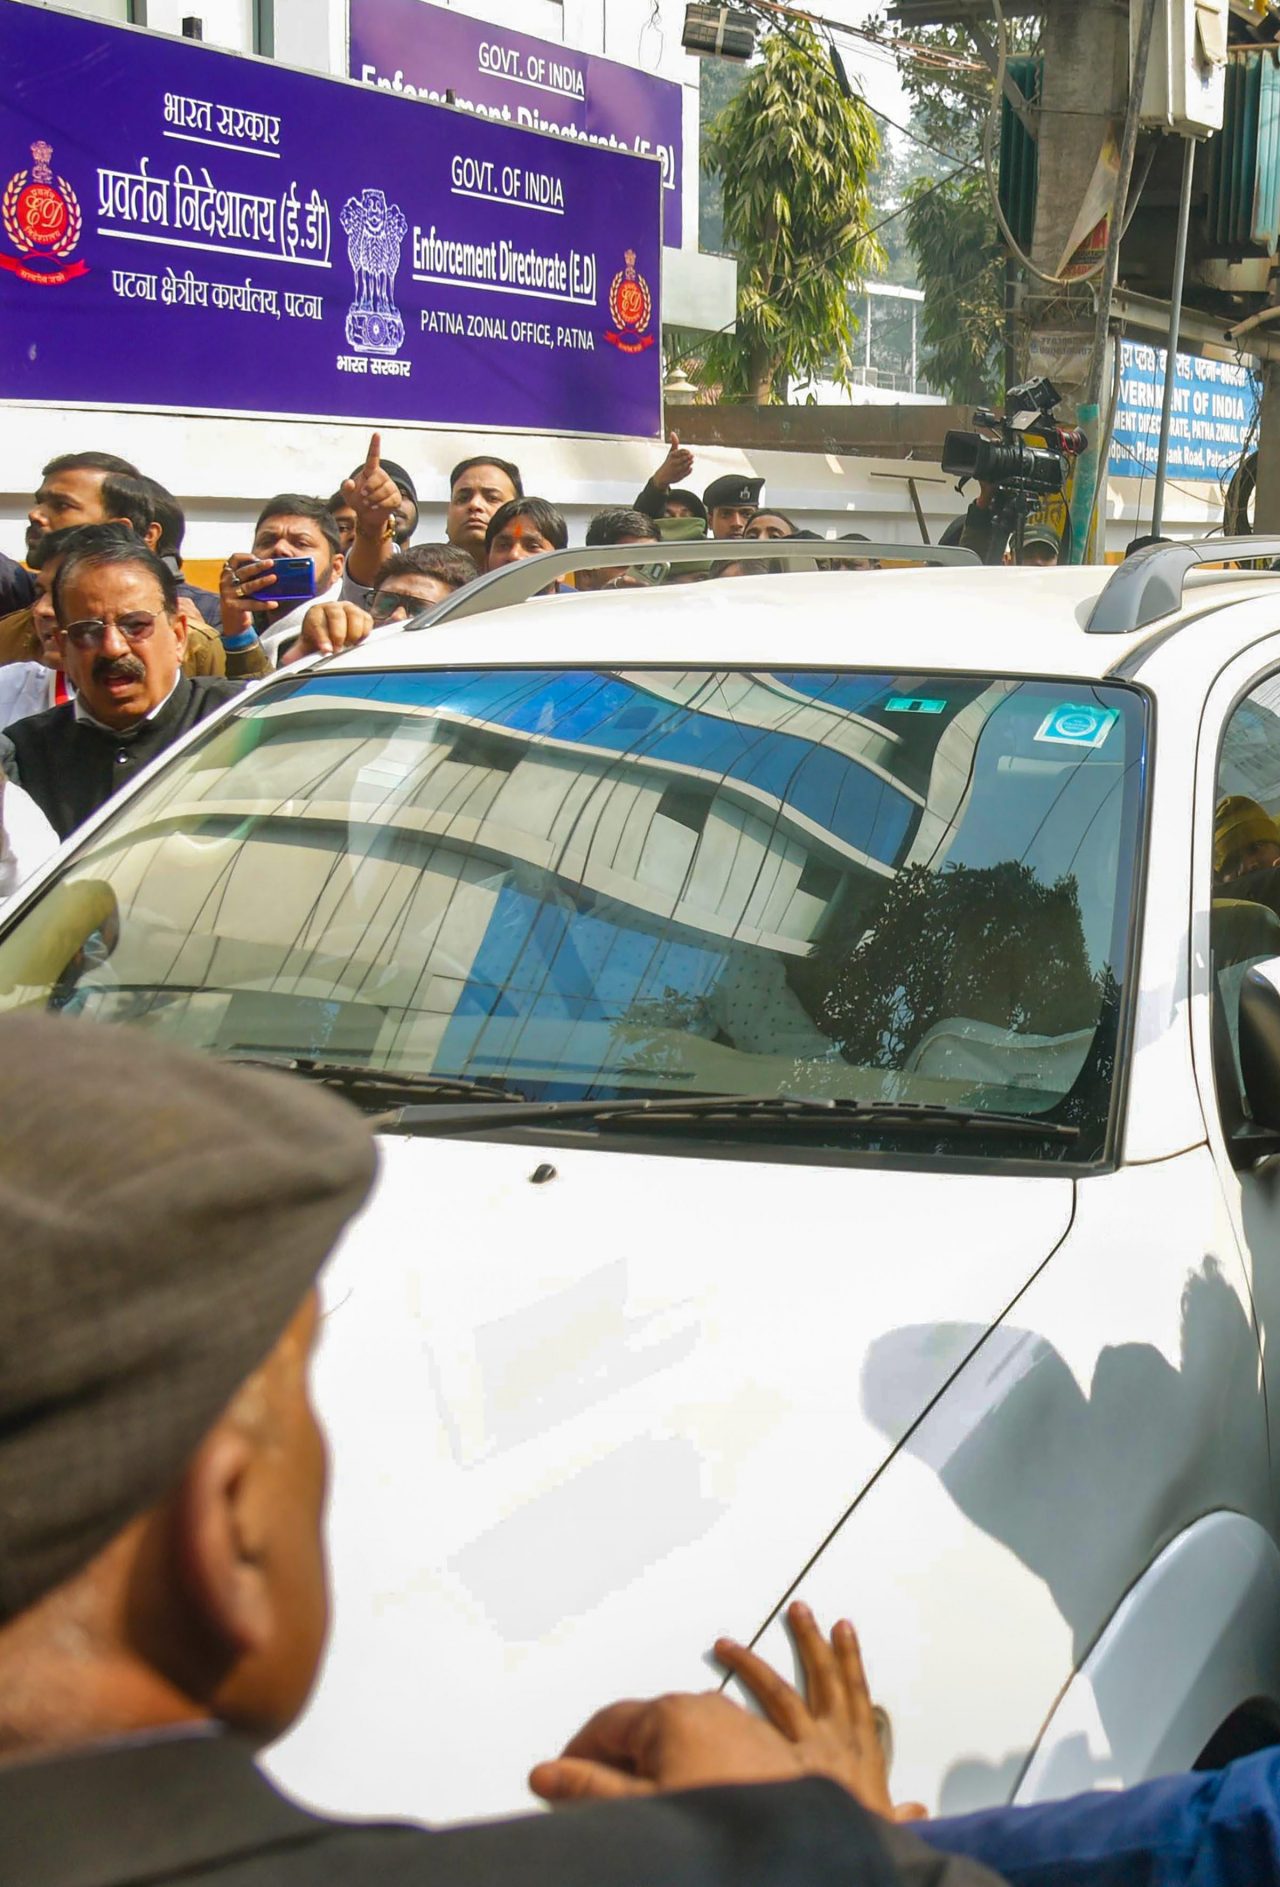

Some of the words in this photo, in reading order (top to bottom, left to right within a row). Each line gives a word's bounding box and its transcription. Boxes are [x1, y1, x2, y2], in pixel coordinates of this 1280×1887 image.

[478, 42, 523, 77] GOVT.
[527, 56, 546, 82] OF
[549, 62, 585, 95] INDIA
[164, 92, 213, 131] भारत
[216, 104, 281, 145] सरकार
[97, 156, 170, 227] प्रवर्तन
[173, 165, 277, 243] निदेशालय
[451, 156, 498, 193] GOVT.
[502, 166, 521, 197] OF
[525, 171, 565, 207] INDIA
[413, 226, 497, 281] Enforcement
[500, 240, 567, 291] Directorate
[569, 250, 597, 300] (E.D)
[112, 270, 158, 301] पटना
[161, 267, 209, 306] क्षेत्रीय
[211, 278, 281, 320] कार्यालय,
[284, 292, 323, 320] पटना
[420, 309, 464, 335] PATNA
[467, 315, 509, 341] ZONAL
[511, 321, 555, 349] OFFICE,
[557, 326, 595, 350] PATNA
[336, 355, 368, 374] भारत
[370, 358, 411, 377] सरकार
[1192, 419, 1216, 441] PATNA
[1216, 423, 1239, 444] ZONAL
[1193, 391, 1209, 415] OF
[1212, 394, 1245, 420] INDIA
